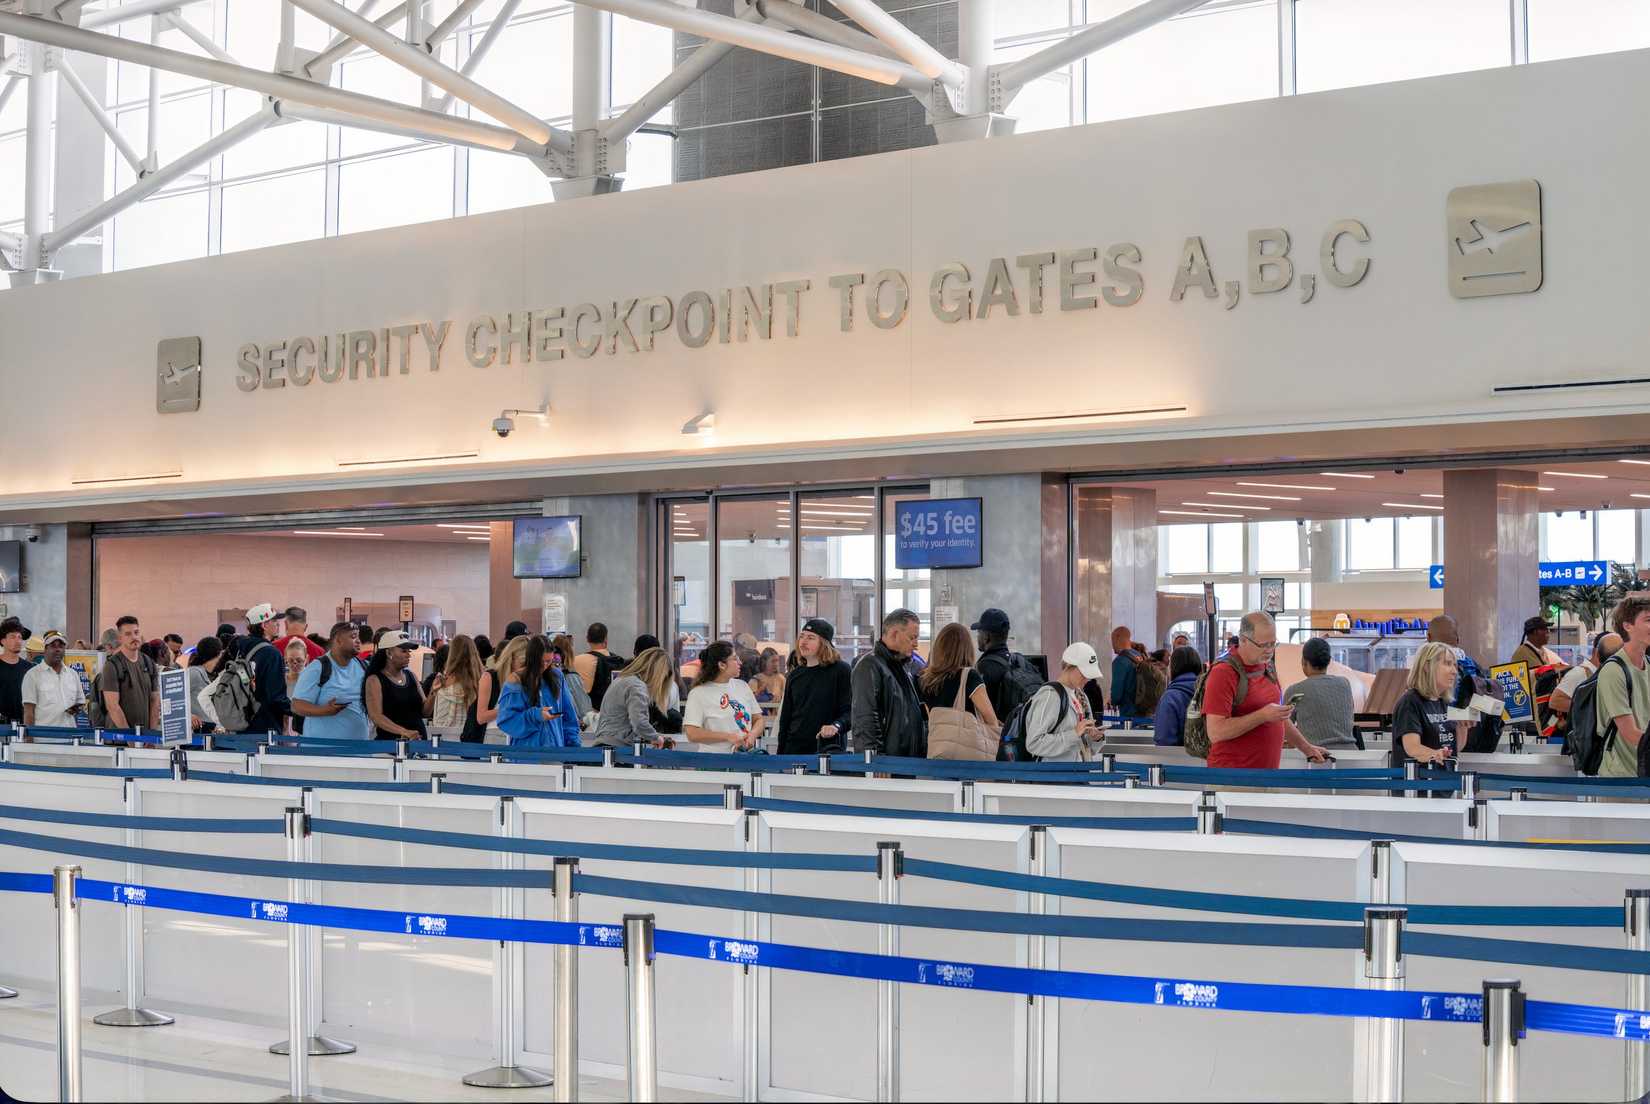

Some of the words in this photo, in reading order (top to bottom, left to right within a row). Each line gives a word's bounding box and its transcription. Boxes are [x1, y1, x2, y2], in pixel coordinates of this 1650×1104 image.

[235, 320, 452, 392] SECURITY
[465, 279, 811, 369] CHECKPOINT
[829, 268, 910, 329] TO
[929, 242, 1144, 323] GATES
[901, 512, 938, 538] $45
[944, 511, 977, 535] fee
[930, 540, 946, 550] your
[1539, 570, 1552, 578] tes
[1554, 568, 1572, 578] A-B
[1175, 983, 1218, 997] BROWARD
[1444, 997, 1484, 1010] BROWAR
